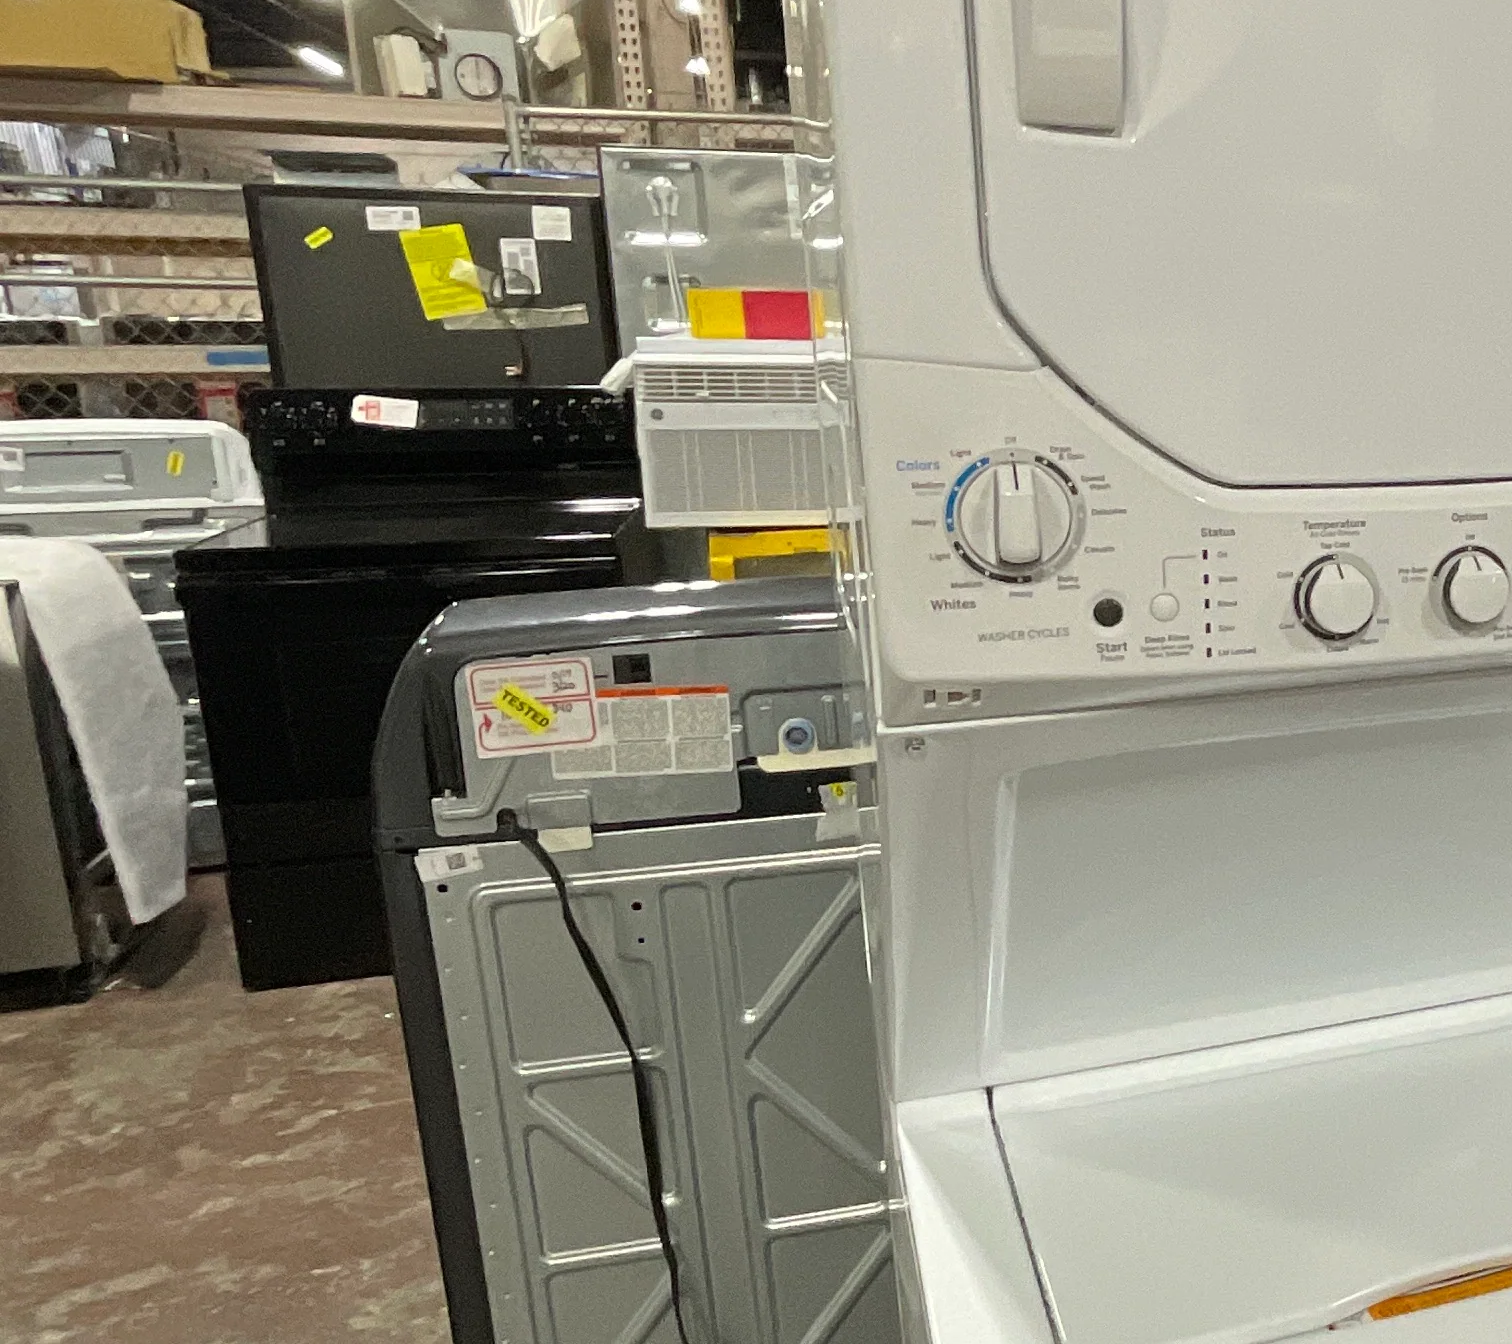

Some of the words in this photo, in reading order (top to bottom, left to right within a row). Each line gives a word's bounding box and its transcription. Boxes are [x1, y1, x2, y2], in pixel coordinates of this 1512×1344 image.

[896, 459, 940, 472] Colors
[1201, 527, 1236, 538] Status
[1303, 520, 1367, 532] Temperature
[930, 598, 977, 611] Whites
[978, 629, 1026, 643] WASHER
[1027, 626, 1070, 640] CYCLES
[1096, 641, 1128, 654] Start
[501, 689, 551, 729] TESTED
